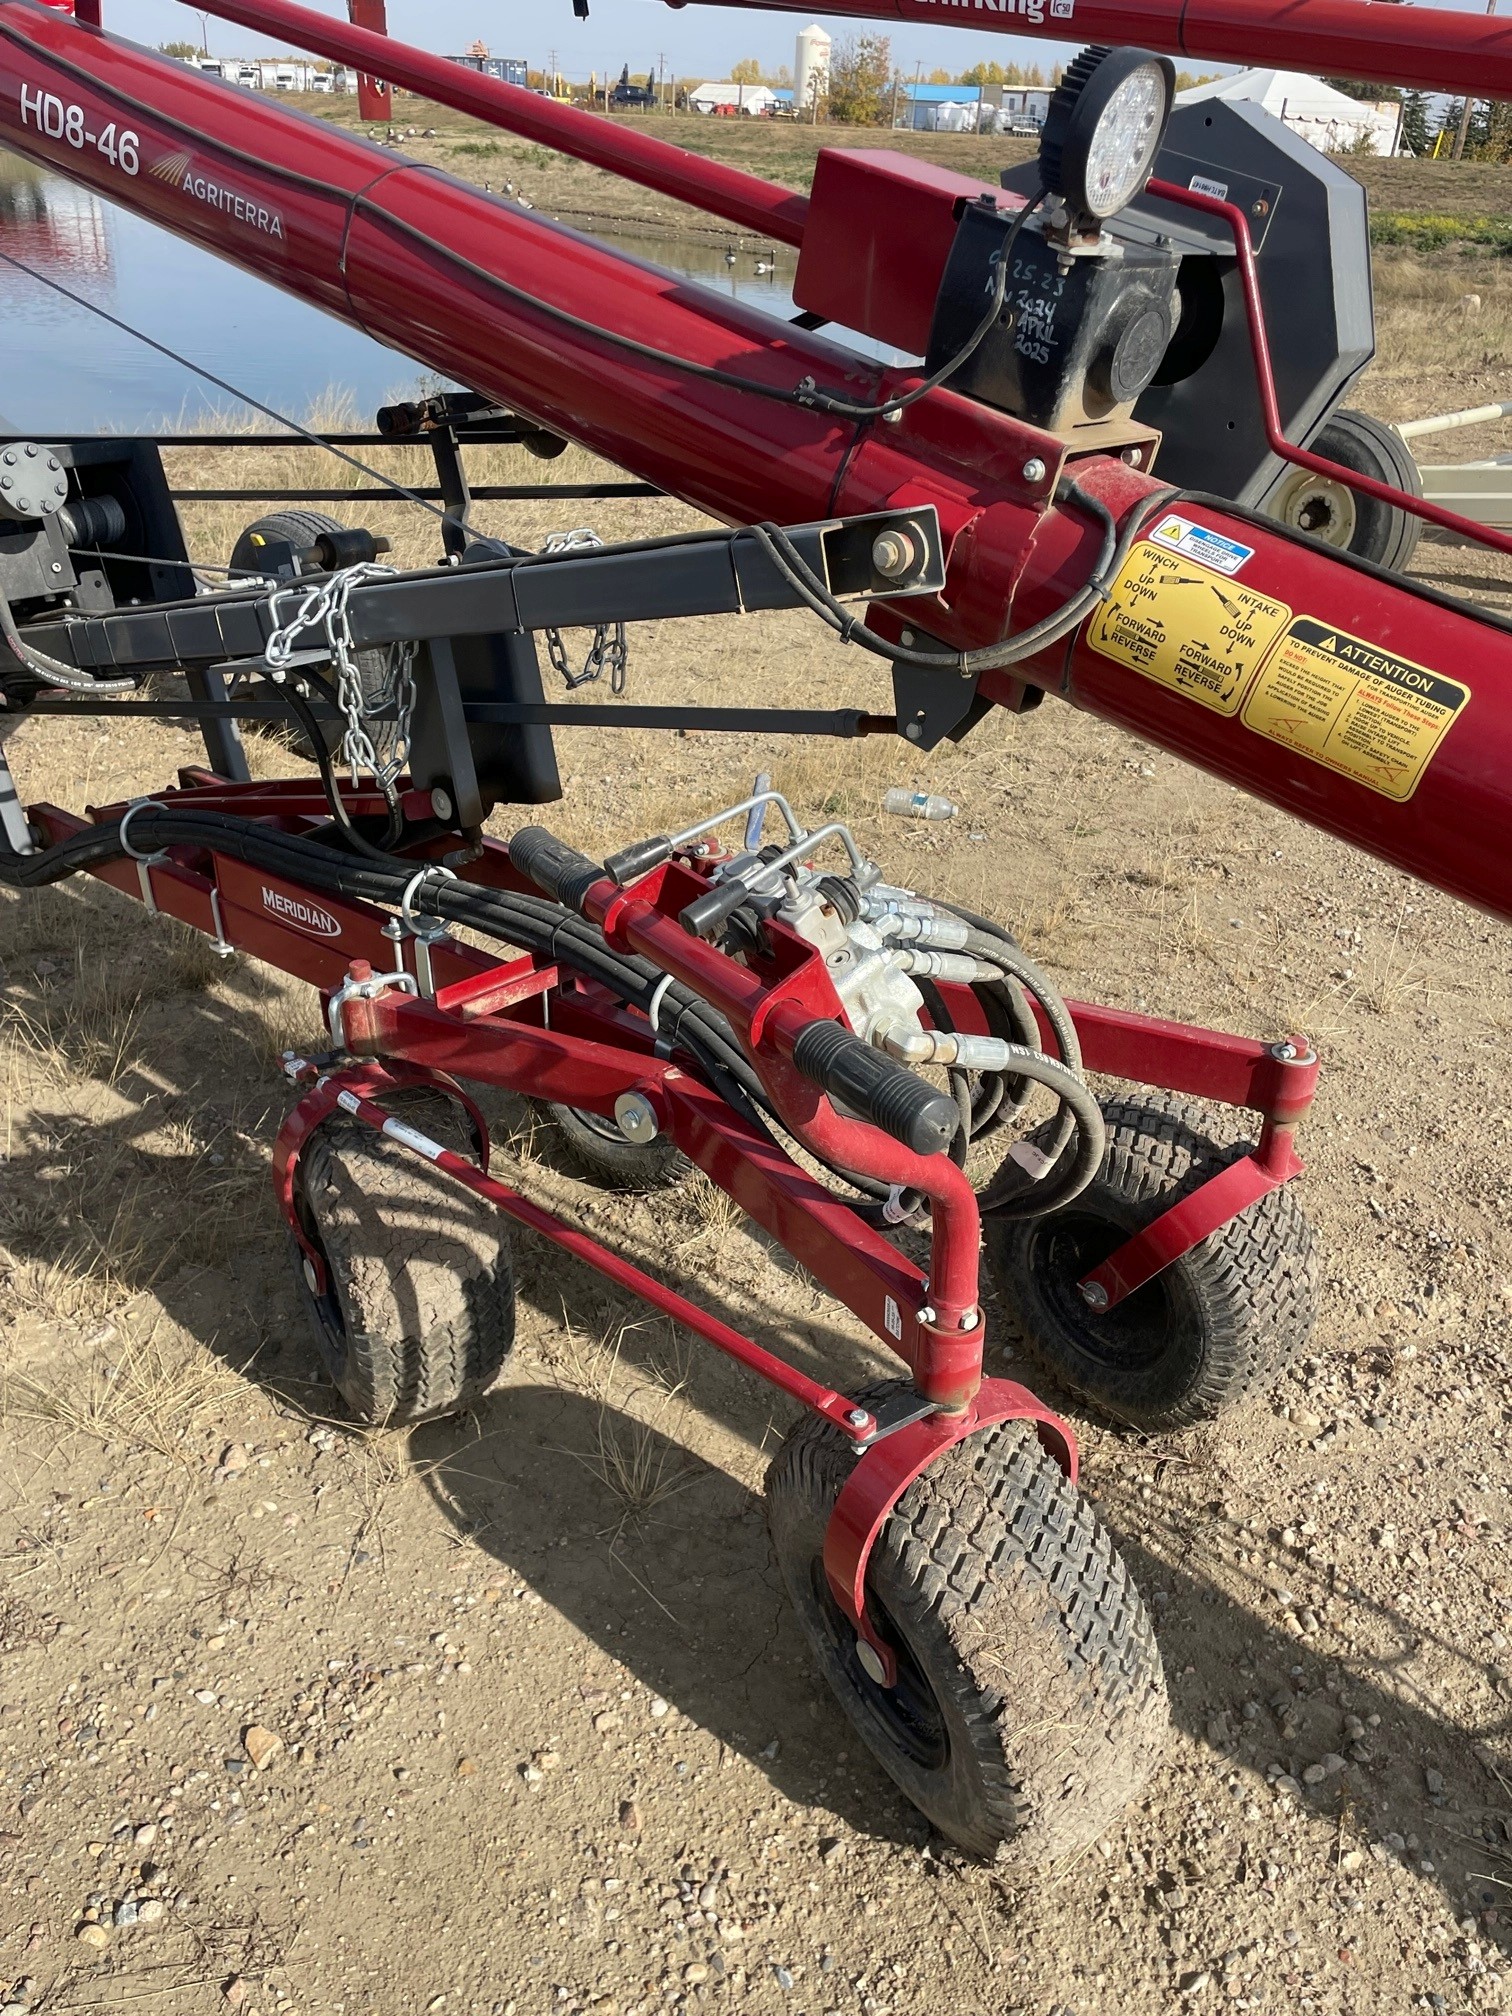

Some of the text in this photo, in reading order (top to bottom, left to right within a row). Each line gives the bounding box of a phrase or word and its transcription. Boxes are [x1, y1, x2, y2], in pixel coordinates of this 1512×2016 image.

[20, 83, 139, 176] HD8-46
[182, 173, 283, 239] AGRITERRA
[1016, 290, 1057, 324] 2024
[1017, 310, 1059, 346] APRIL
[1015, 334, 1050, 365] 2025
[1189, 536, 1238, 561] DISENGAGE DRIVE
[1193, 543, 1228, 561] WHEELS FOR
[1204, 534, 1236, 550] NOTICE
[1142, 548, 1180, 571] WINCH
[1123, 579, 1158, 601] DOWN
[1138, 574, 1155, 586] UP
[1237, 593, 1280, 618] INTAKE
[1115, 612, 1167, 644] FORWARD
[1219, 625, 1256, 648] DOWN
[1235, 619, 1252, 632] UP
[1110, 633, 1157, 660] REVERSE
[1179, 644, 1233, 676] FORWARD
[1173, 664, 1222, 693] REVERSE
[1277, 665, 1296, 677] WOULD
[1304, 678, 1331, 693] REQUIRED
[1279, 658, 1299, 670] EXCEED
[1310, 673, 1330, 684] HEIGHT
[1331, 682, 1345, 691] THAT
[1288, 640, 1447, 715] TO PREVENT DAMAGE OF AUGER TUBING
[1339, 644, 1434, 693] ATTENTION
[1266, 683, 1300, 702] APPLICATION
[1307, 703, 1330, 716] RAISING
[1275, 680, 1294, 691] AUGER
[1293, 688, 1305, 696] FOR
[1315, 699, 1327, 707] JOB
[1277, 673, 1296, 684] SAFELY
[1296, 682, 1321, 696] POSITION
[1269, 692, 1296, 708] LOWERING
[1296, 705, 1307, 713] THE
[1307, 710, 1326, 722] AUGER
[1357, 688, 1441, 730] ALWAYS Follow These Steps:
[1361, 701, 1380, 713] LOWER
[1380, 710, 1399, 722] AUGER
[1408, 723, 1420, 731] THE
[1366, 684, 1439, 720] FOR TRANSPORTING AUGER
[1350, 720, 1366, 730] RAISE
[1366, 728, 1387, 740] INTAKE
[1387, 738, 1400, 746] LIFT
[1352, 715, 1369, 725] HOOK
[1358, 706, 1417, 736] LOWEST (TRANSPORT)
[1268, 728, 1293, 743] ALWAYS
[1293, 740, 1314, 753] REFER
[1324, 755, 1352, 772] OWNERS
[1352, 769, 1380, 786] MANUAL
[1343, 734, 1369, 749] CONNECT
[1368, 747, 1390, 759] SAFETY
[1389, 757, 1408, 768] CHAIN
[1348, 725, 1375, 740] ASSEMBLY
[1385, 743, 1417, 760] TRANSPORT
[1349, 743, 1361, 751] LIFT
[261, 886, 332, 933] MERIDIAN
[1010, 1045, 1030, 1056] 1SN
